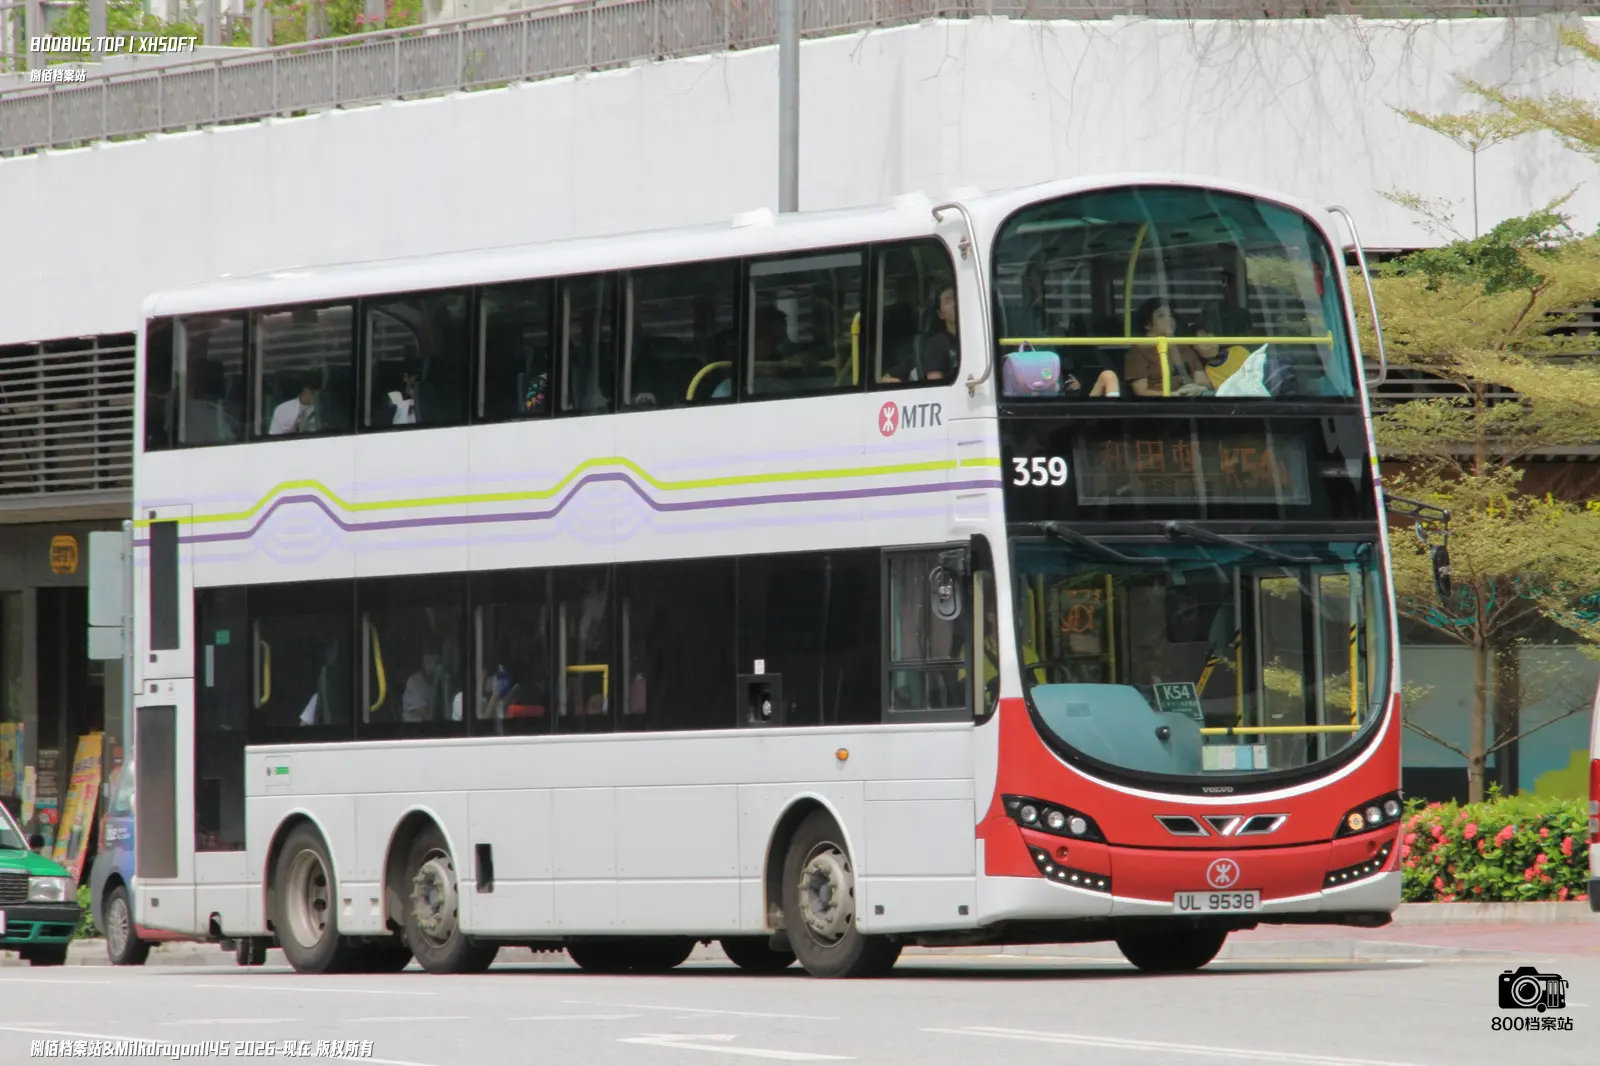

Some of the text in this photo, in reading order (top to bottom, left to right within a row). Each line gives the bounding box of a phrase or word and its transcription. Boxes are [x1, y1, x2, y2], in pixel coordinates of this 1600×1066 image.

[901, 403, 942, 429] MTR
[1012, 456, 1067, 486] 359
[1163, 685, 1190, 700] K54
[1179, 894, 1255, 910] UL 9538
